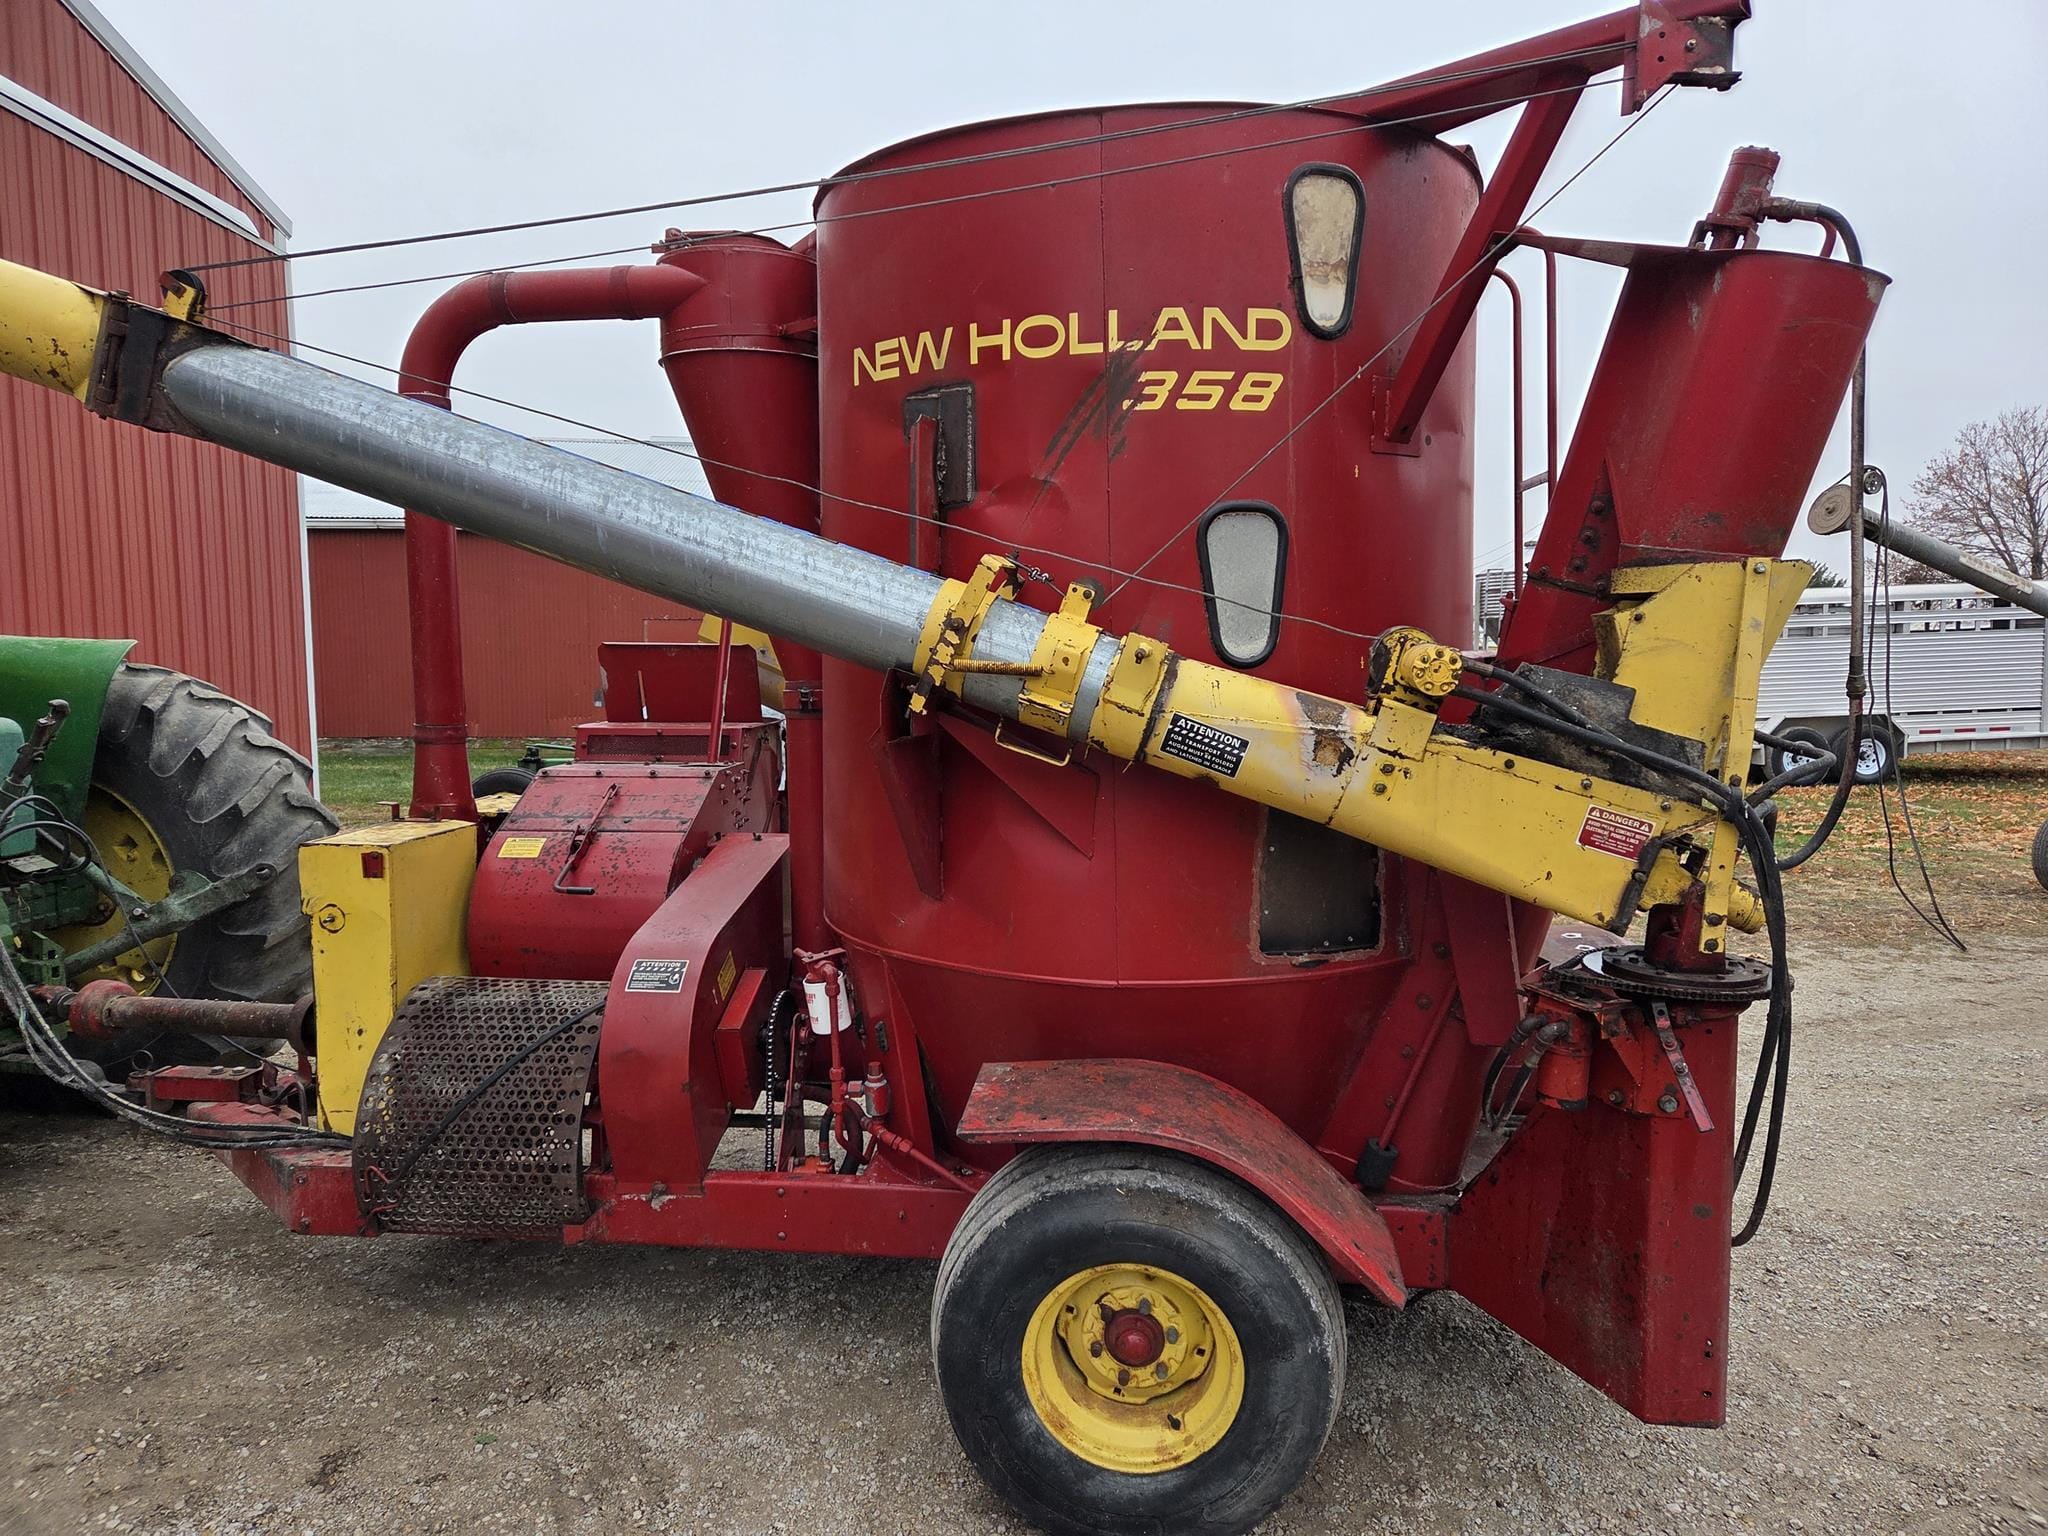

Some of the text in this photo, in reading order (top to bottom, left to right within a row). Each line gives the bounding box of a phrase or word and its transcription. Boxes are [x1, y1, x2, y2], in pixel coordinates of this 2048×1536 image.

[853, 307, 1292, 386] NEW HOLLAND
[1122, 370, 1284, 412] 358
[1171, 733, 1237, 762] FOR TRANSPORT THIS
[1177, 718, 1241, 748] ATTENTION
[1168, 741, 1188, 751] AUGER
[1188, 748, 1204, 756] MUST
[1212, 757, 1234, 768] FOLDED
[1180, 751, 1202, 763] LATCHED
[1211, 763, 1232, 774] CRADLE
[1602, 811, 1640, 828] DANGER
